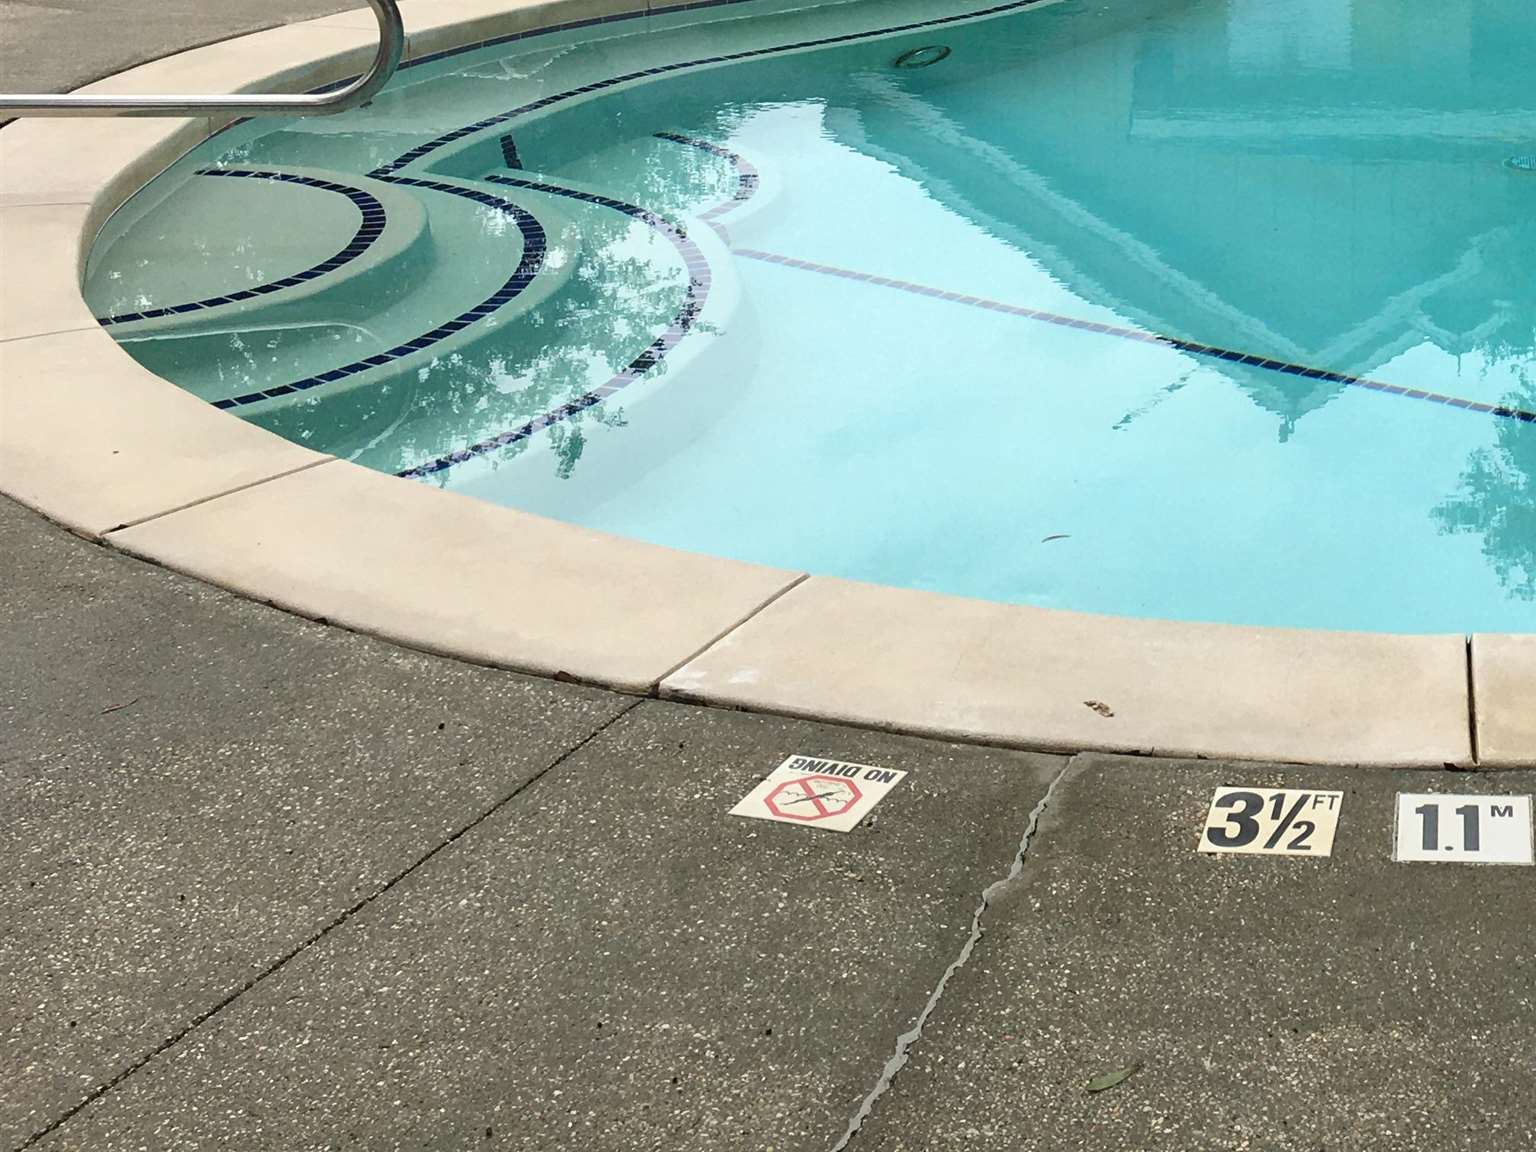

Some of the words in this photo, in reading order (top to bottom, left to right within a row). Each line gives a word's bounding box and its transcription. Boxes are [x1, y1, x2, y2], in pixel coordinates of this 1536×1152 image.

[789, 758, 862, 778] DIVING
[863, 767, 897, 784] NO
[1311, 794, 1341, 811] FT
[1415, 803, 1481, 852] 1.1
[1490, 805, 1514, 818] M
